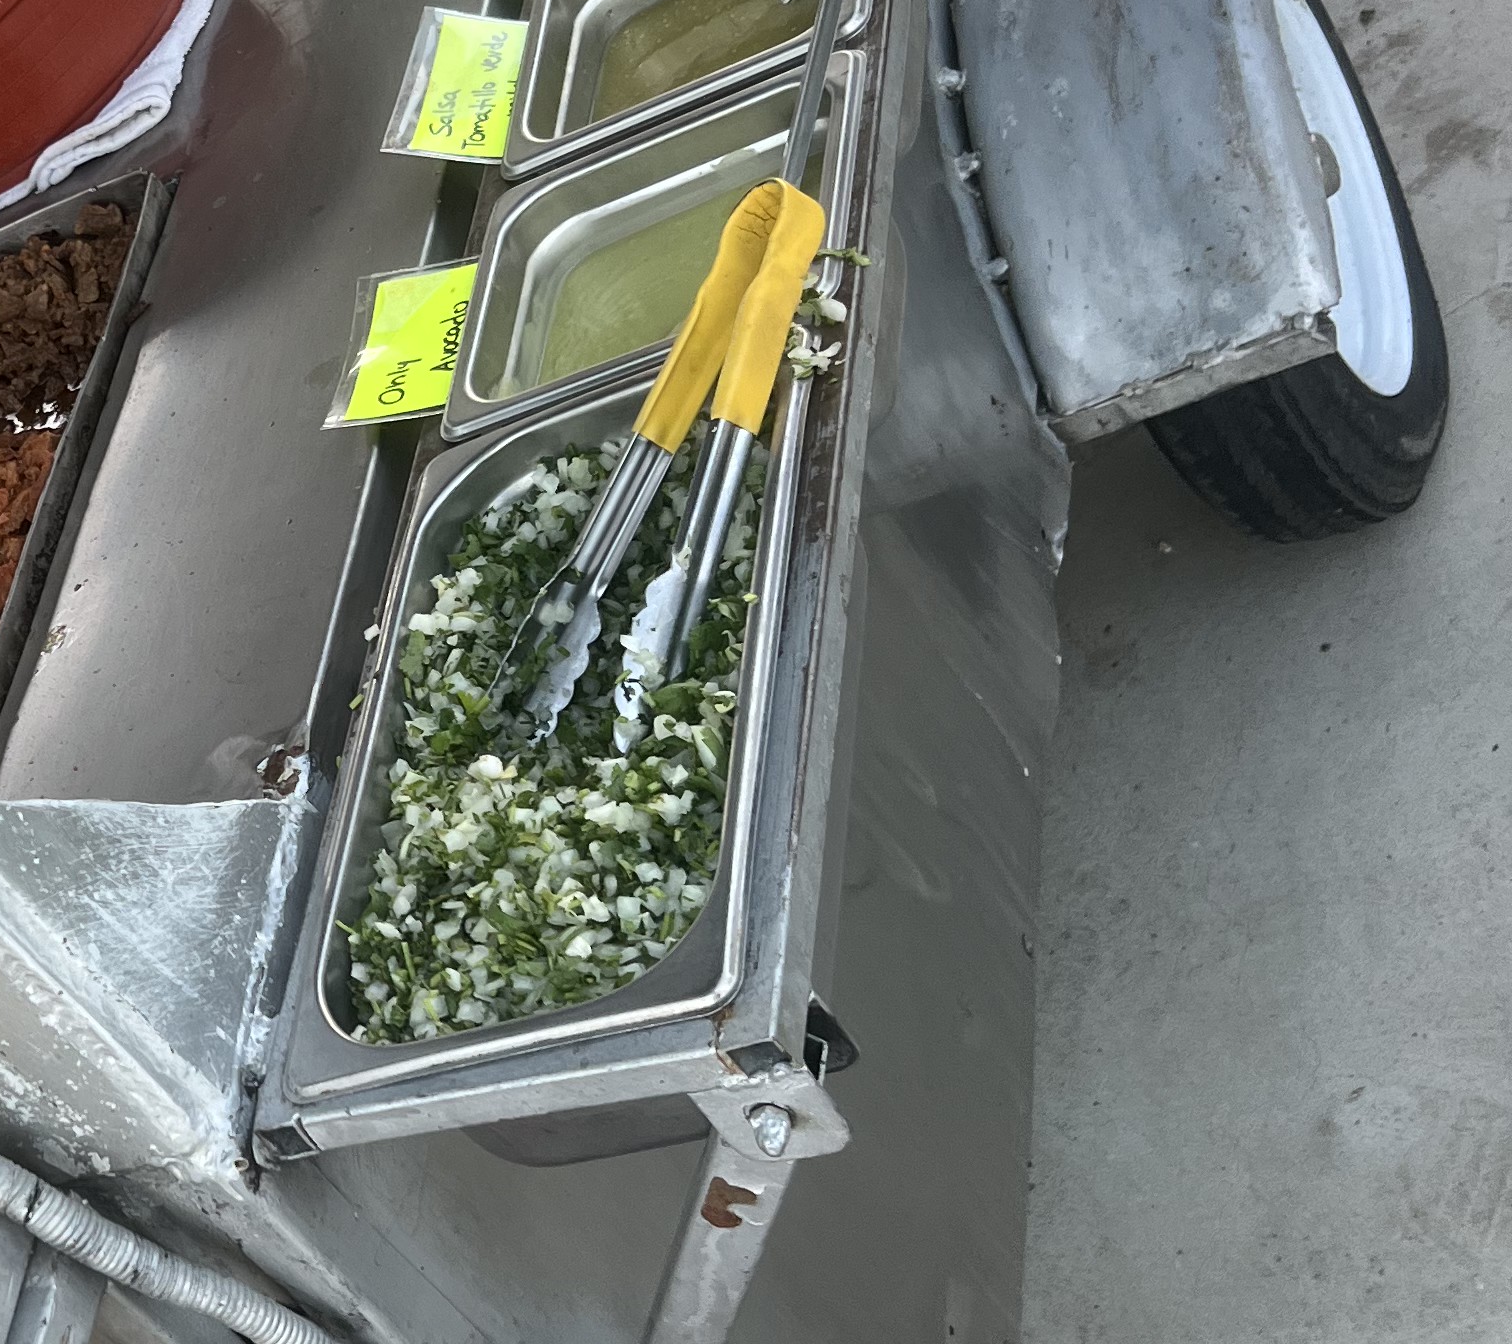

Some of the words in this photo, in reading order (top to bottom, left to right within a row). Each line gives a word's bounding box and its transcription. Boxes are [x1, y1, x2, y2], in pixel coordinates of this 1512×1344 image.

[429, 89, 462, 137] Salsa
[461, 81, 497, 150] Tomatillo
[430, 300, 470, 372] Avocado
[378, 358, 423, 405] Only
